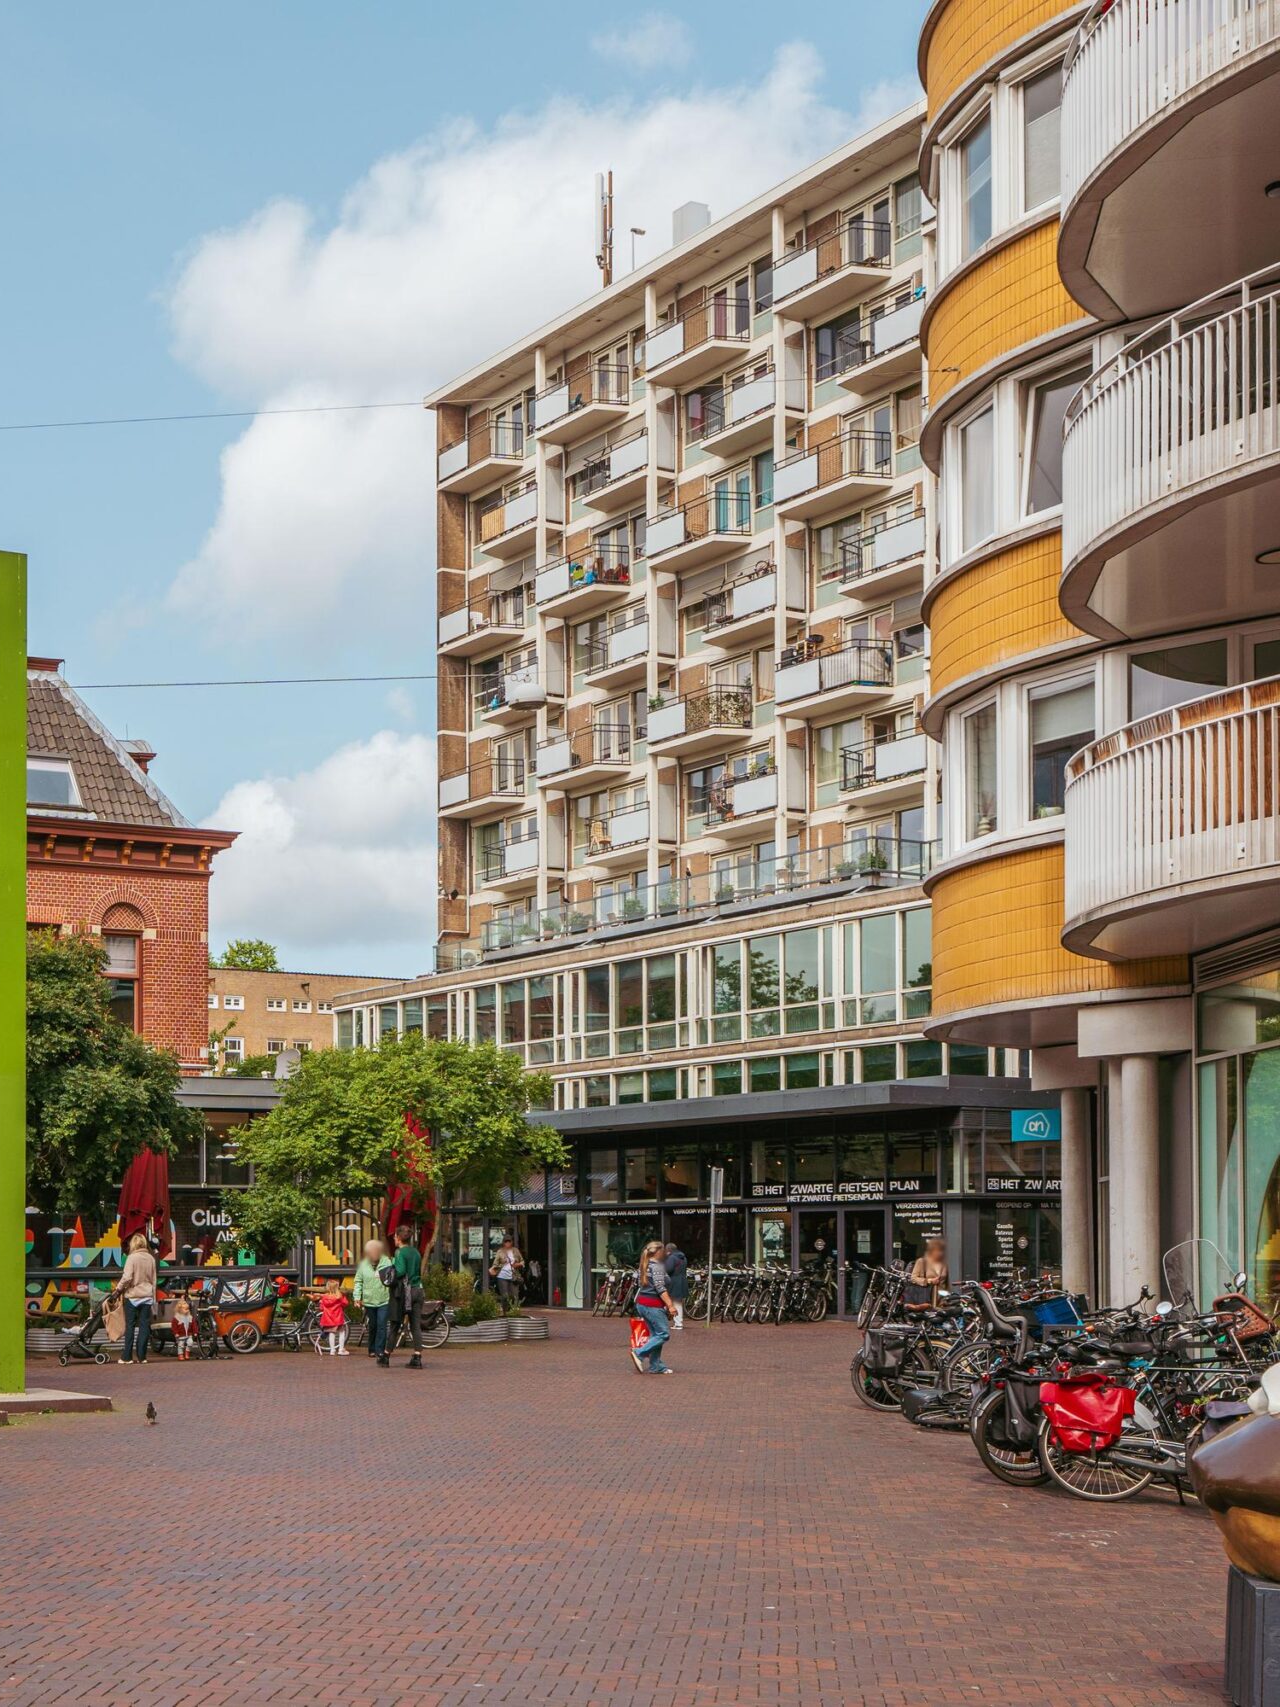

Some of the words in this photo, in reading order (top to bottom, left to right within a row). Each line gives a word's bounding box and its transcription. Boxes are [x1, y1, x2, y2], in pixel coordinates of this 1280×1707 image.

[764, 1185, 784, 1195] HET
[790, 1183, 834, 1195] ZWARTE
[838, 1181, 884, 1193] FIETSEN
[889, 1180, 920, 1191] PLAN
[1000, 1179, 1020, 1189] HET
[787, 1194, 801, 1203] HET
[801, 1194, 832, 1202] ZWARTE
[832, 1192, 884, 1202] FIETSENPLAN
[509, 1203, 545, 1211] FIETSENPLAN
[191, 1208, 232, 1226] Club
